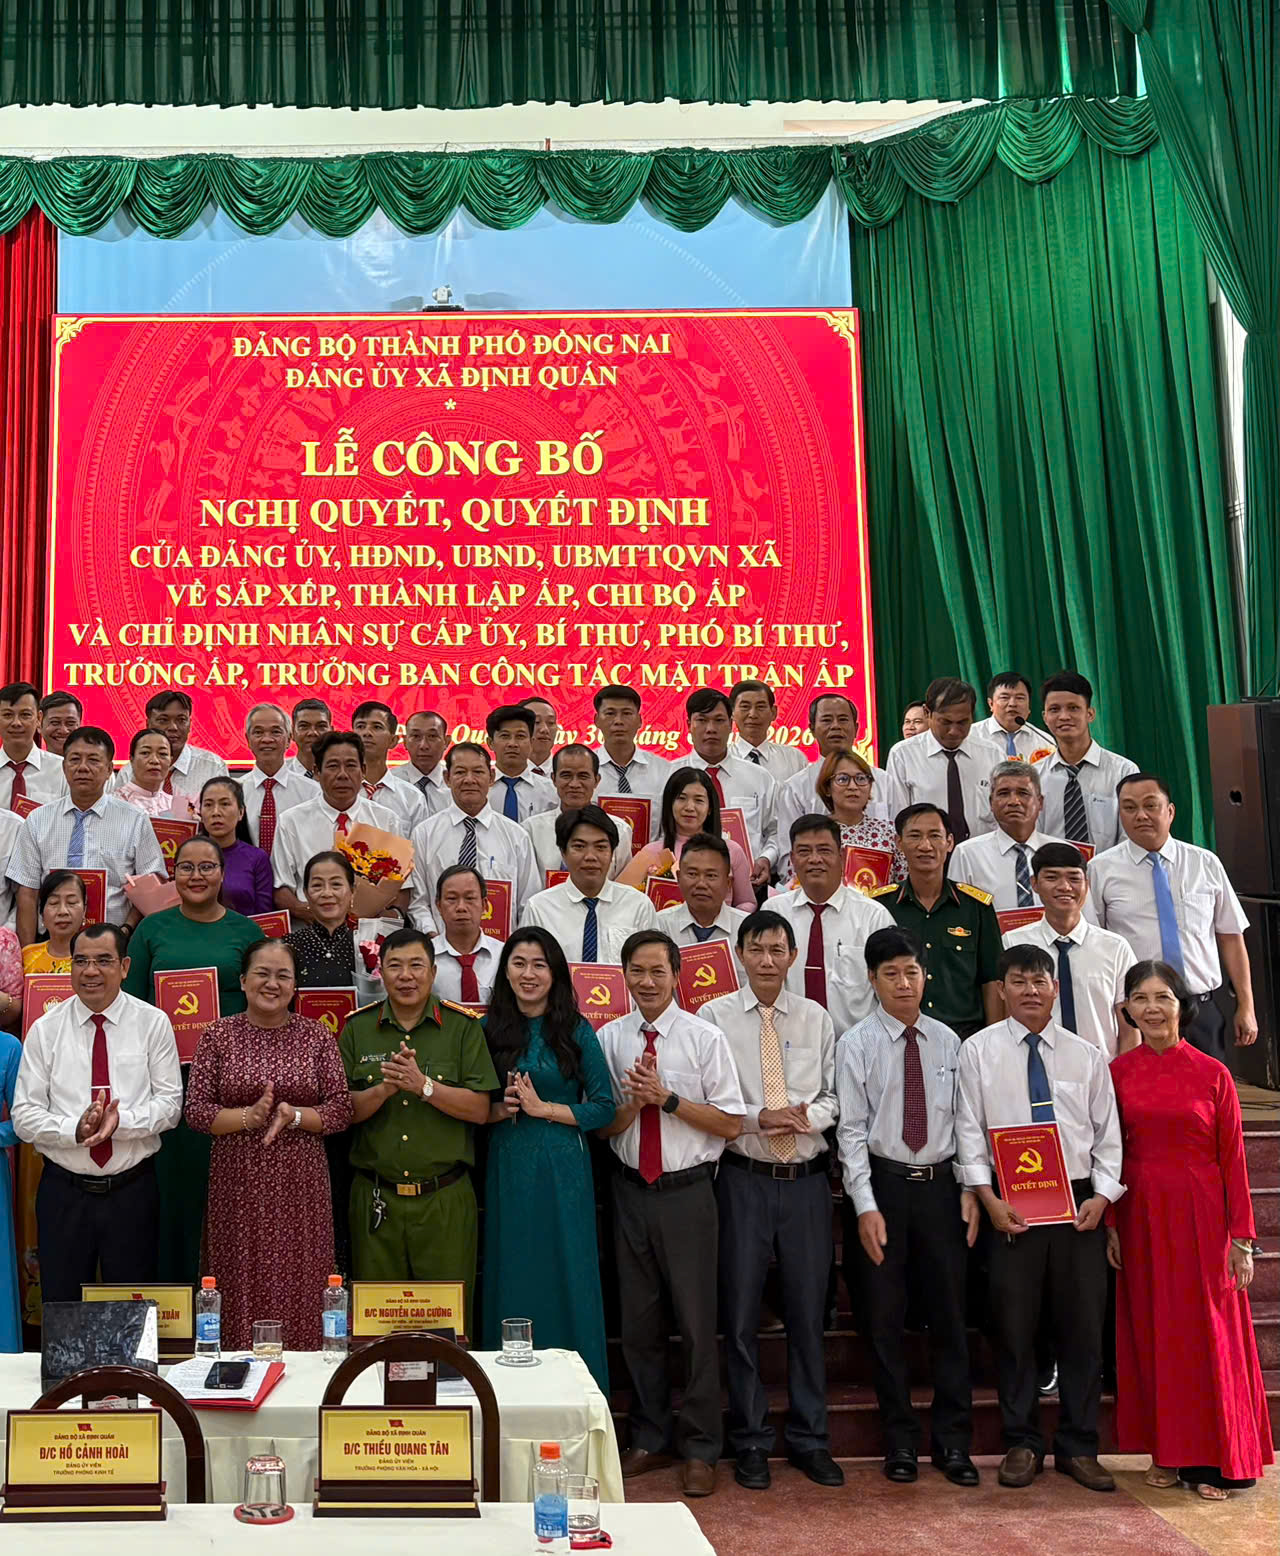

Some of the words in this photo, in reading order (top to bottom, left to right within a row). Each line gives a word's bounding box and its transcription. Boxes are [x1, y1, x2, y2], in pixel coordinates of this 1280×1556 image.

[232, 330, 312, 357] ĐẢNG
[318, 333, 357, 362] BỘ
[362, 329, 461, 357] THÀNH
[467, 329, 527, 356] PHỐ
[532, 328, 615, 355] ĐỒNG
[620, 333, 671, 354] NAI
[285, 359, 364, 389] ĐẢNG
[371, 361, 410, 388] ỦY
[415, 362, 455, 388] XÃ
[460, 366, 532, 393] ĐỊNH
[538, 360, 619, 391] QUÁN
[300, 427, 359, 476] LỄ
[372, 431, 524, 477] CÔNG
[535, 429, 604, 475] BỐ
[199, 499, 300, 534] NGHỊ
[309, 490, 452, 533] QUYẾT,
[461, 489, 598, 533] QUYẾT
[607, 497, 710, 534] ĐỊNH
[129, 539, 194, 569] CỦA
[199, 538, 287, 568] ĐẢNG
[294, 538, 342, 572] ỦY,
[349, 544, 444, 572] HĐND,
[451, 544, 545, 572] UBND,
[552, 544, 730, 572] UBMTTQVN
[737, 539, 783, 568] XÃ
[166, 578, 207, 607] VỀ
[215, 577, 272, 607] SẮP
[277, 577, 342, 611] XẾP,
[348, 577, 458, 607] THÀNH
[465, 580, 526, 613] LẬP
[534, 577, 580, 611] ẤP,
[587, 583, 645, 607] CHI
[652, 580, 697, 613] BỘ
[705, 577, 746, 607] ẤP
[68, 617, 112, 646] VÀ
[118, 616, 176, 647] CHỈ
[181, 623, 260, 652] ĐỊNH
[267, 616, 355, 646] NHÂN
[362, 619, 405, 652] SỰ
[410, 616, 473, 647] CẤP
[477, 616, 527, 651] ỦY,
[535, 617, 568, 647] BÍ
[573, 619, 651, 651] THƯ,
[657, 617, 725, 648] PHÓ
[732, 617, 765, 647] BÍ
[771, 620, 849, 652] THƯ,
[63, 656, 197, 687] TRƯỞNG
[203, 656, 249, 690] ẤP,
[256, 655, 391, 686] TRƯỞNG
[398, 663, 461, 686] BAN
[469, 655, 561, 687] CÔNG
[567, 656, 632, 687] TÁC
[639, 660, 712, 693] MẶT
[717, 660, 805, 688] TRẬN
[813, 657, 854, 688] ẤP
[767, 725, 815, 747] 2026
[1011, 1180, 1036, 1192] QUYẾT
[1038, 1180, 1058, 1190] ĐỊNH
[410, 1308, 425, 1318] CAO
[40, 1447, 56, 1460] Đ/C
[76, 1443, 102, 1459] CẢNH
[106, 1444, 129, 1459] HOÀI
[344, 1443, 360, 1455] Đ/C
[394, 1442, 427, 1456] QUANG
[429, 1440, 449, 1455] TÂN
